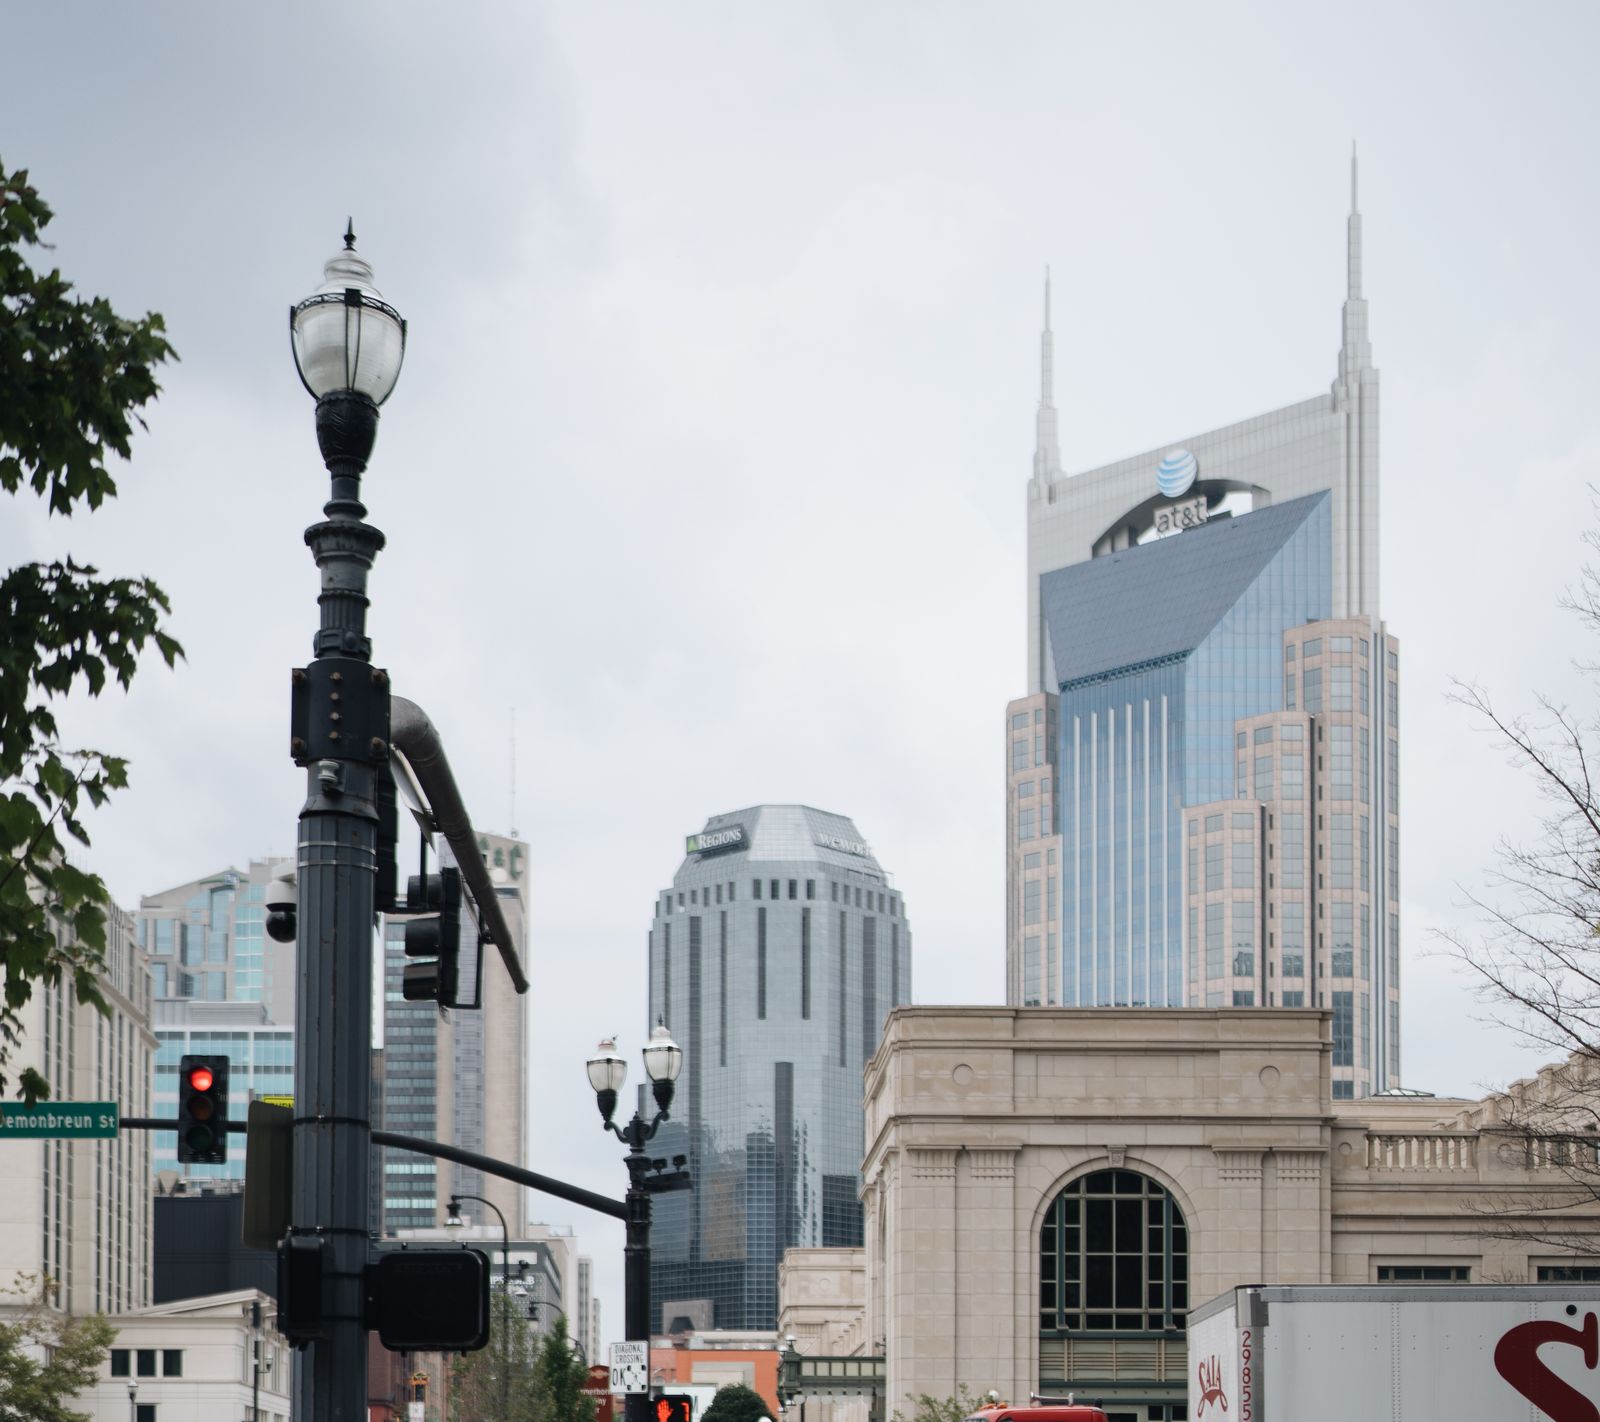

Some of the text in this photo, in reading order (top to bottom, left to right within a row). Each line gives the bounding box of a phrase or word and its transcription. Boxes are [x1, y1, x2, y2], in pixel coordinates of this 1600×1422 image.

[1156, 499, 1206, 533] at&t
[99, 1115, 116, 1129] St
[614, 1344, 644, 1354] DIAGONAL
[615, 1354, 644, 1365] CROSSING
[612, 1368, 627, 1387] OK
[1197, 1353, 1229, 1419] SAIA
